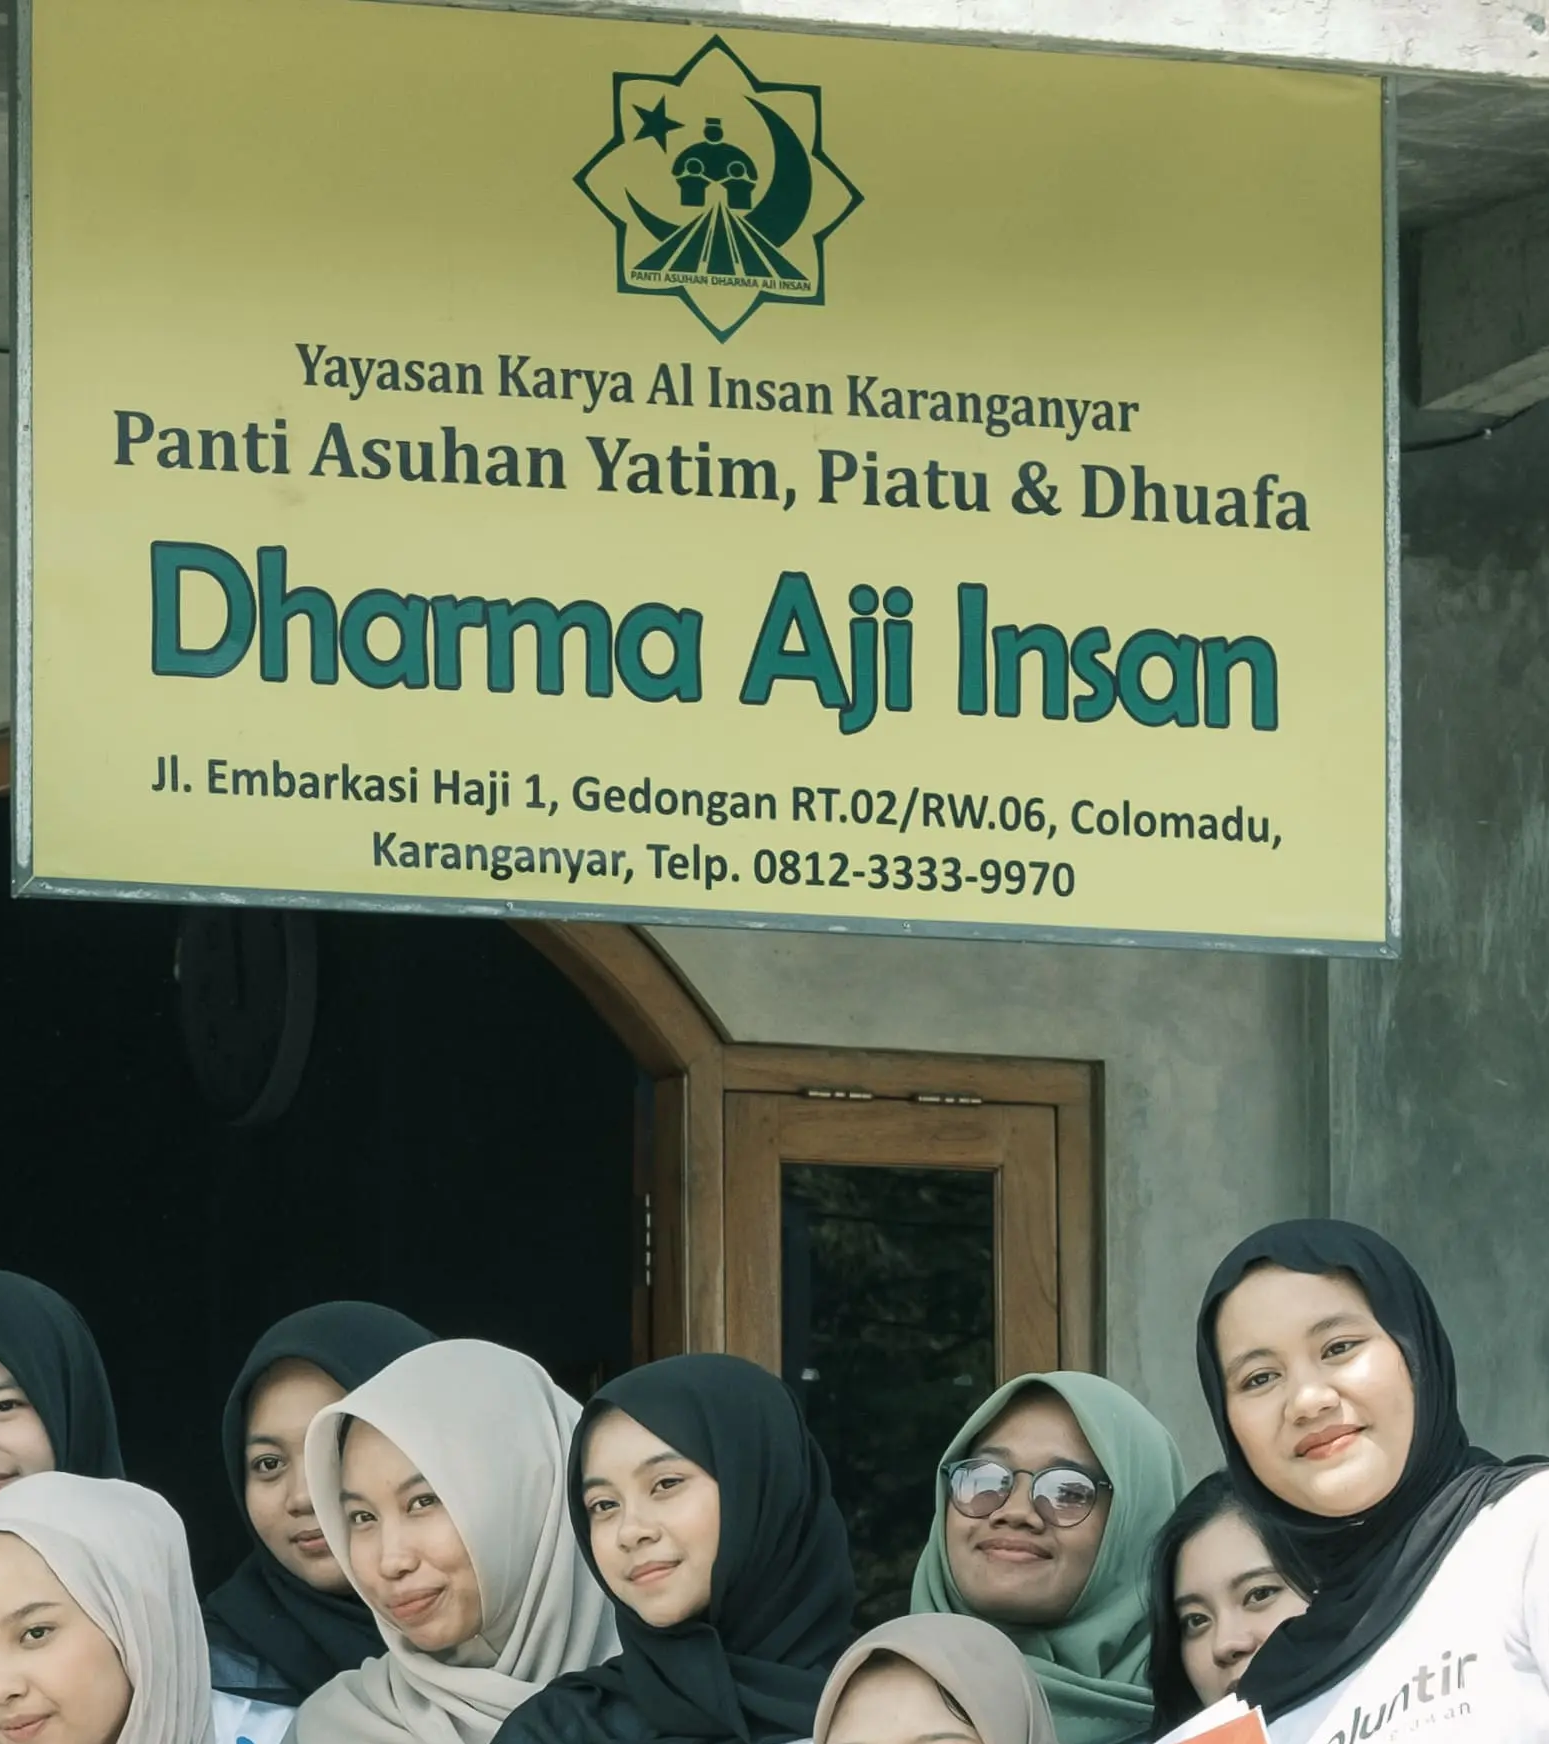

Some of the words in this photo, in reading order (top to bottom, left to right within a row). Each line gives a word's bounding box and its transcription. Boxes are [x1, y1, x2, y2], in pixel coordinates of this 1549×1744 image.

[631, 271, 661, 281] PANTI
[664, 273, 708, 286] ASUHAN
[711, 276, 759, 288] DHARMA
[762, 279, 776, 289] AJI
[779, 280, 811, 291] INSAN
[295, 344, 483, 400] Yayasan
[498, 355, 634, 412] Karya
[647, 363, 693, 406] Al
[708, 367, 832, 414] Insan
[847, 375, 1139, 438] Karanganyar
[114, 410, 290, 474] Panti
[309, 423, 566, 489] Asuhan
[586, 436, 795, 510] Yatim,
[818, 449, 990, 512] Piatu
[1012, 463, 1061, 516] &
[1081, 468, 1310, 531] Dhuafa
[151, 540, 702, 703] Dharma
[739, 571, 913, 734] Aji
[958, 582, 1278, 731] Insan
[152, 755, 192, 793] Jl.
[207, 759, 417, 805] Embarkasi
[434, 768, 511, 815] Haji
[525, 774, 559, 816] 1,
[572, 774, 777, 826] Gedongan
[792, 786, 1057, 839] RT.02/RW.06,
[1071, 799, 1282, 849] Colomadu,
[374, 832, 633, 884] Karanganyar,
[646, 844, 740, 890] Telp.
[754, 848, 1075, 897] 0812-3333-9970
